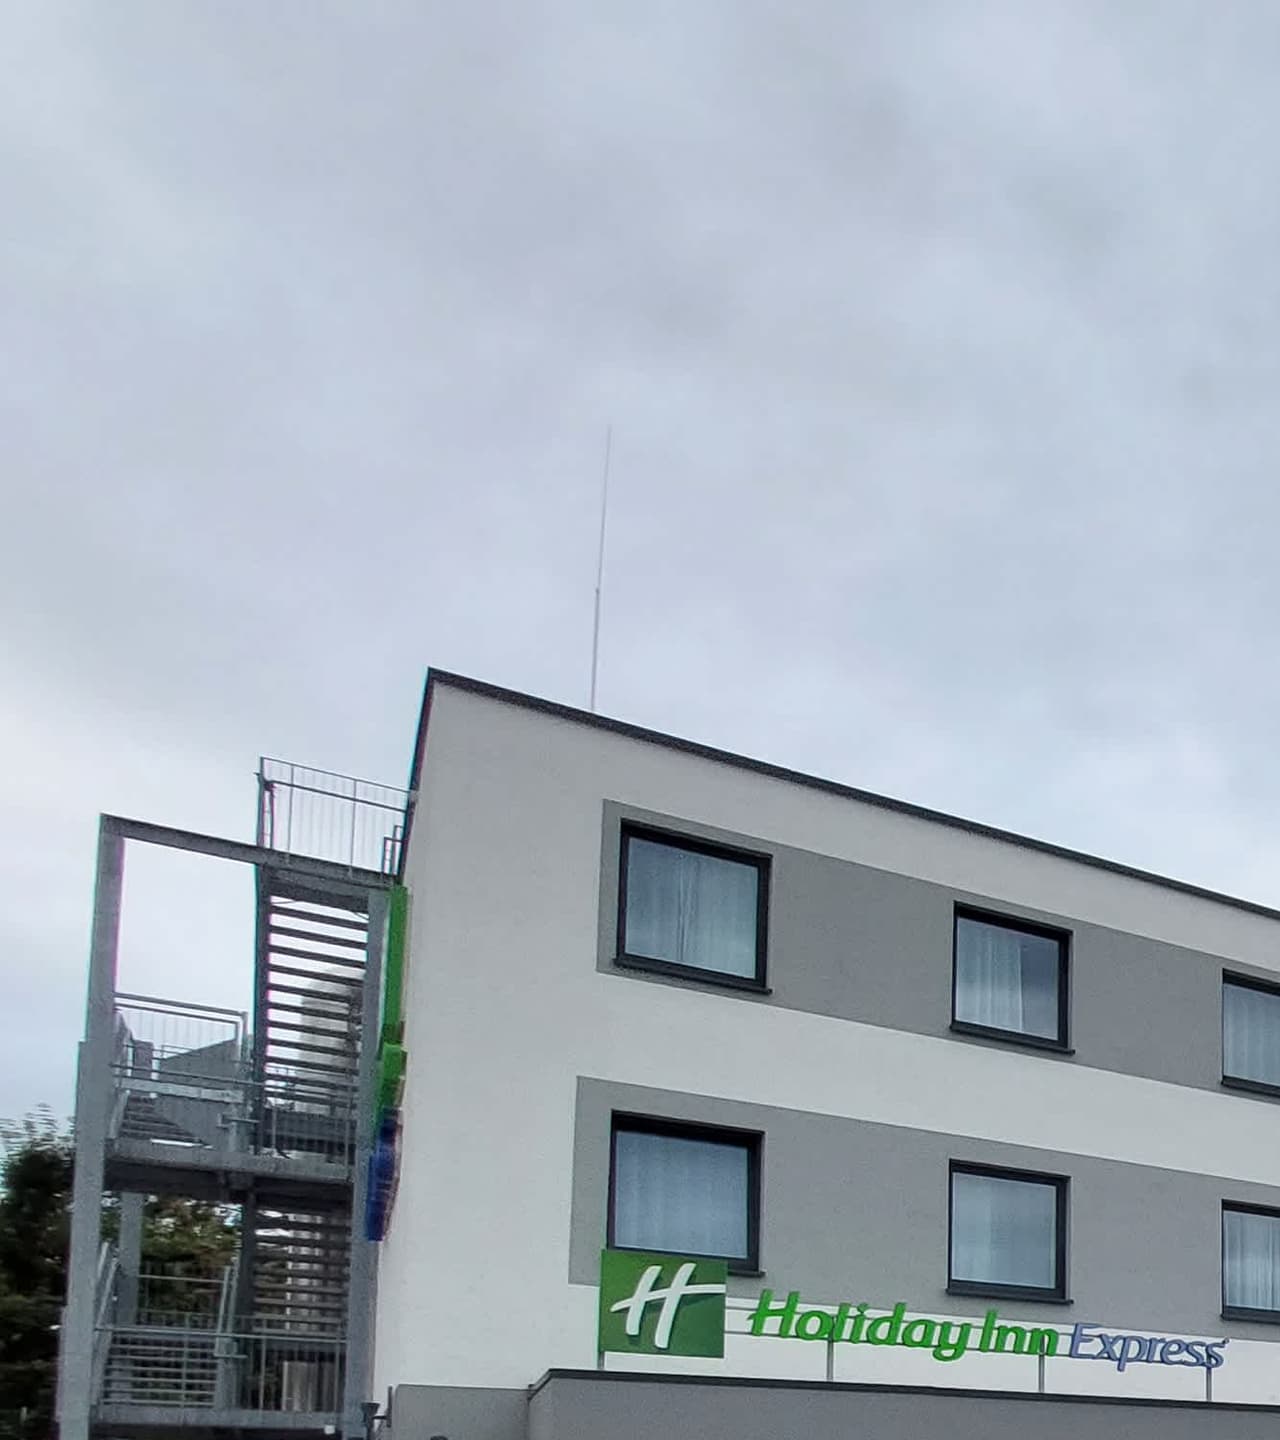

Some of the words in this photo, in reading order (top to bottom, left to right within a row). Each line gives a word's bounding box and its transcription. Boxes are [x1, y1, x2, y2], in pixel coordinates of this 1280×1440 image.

[747, 1288, 972, 1362] Holiday
[979, 1309, 1057, 1356] Inn
[1068, 1321, 1226, 1373] Express
